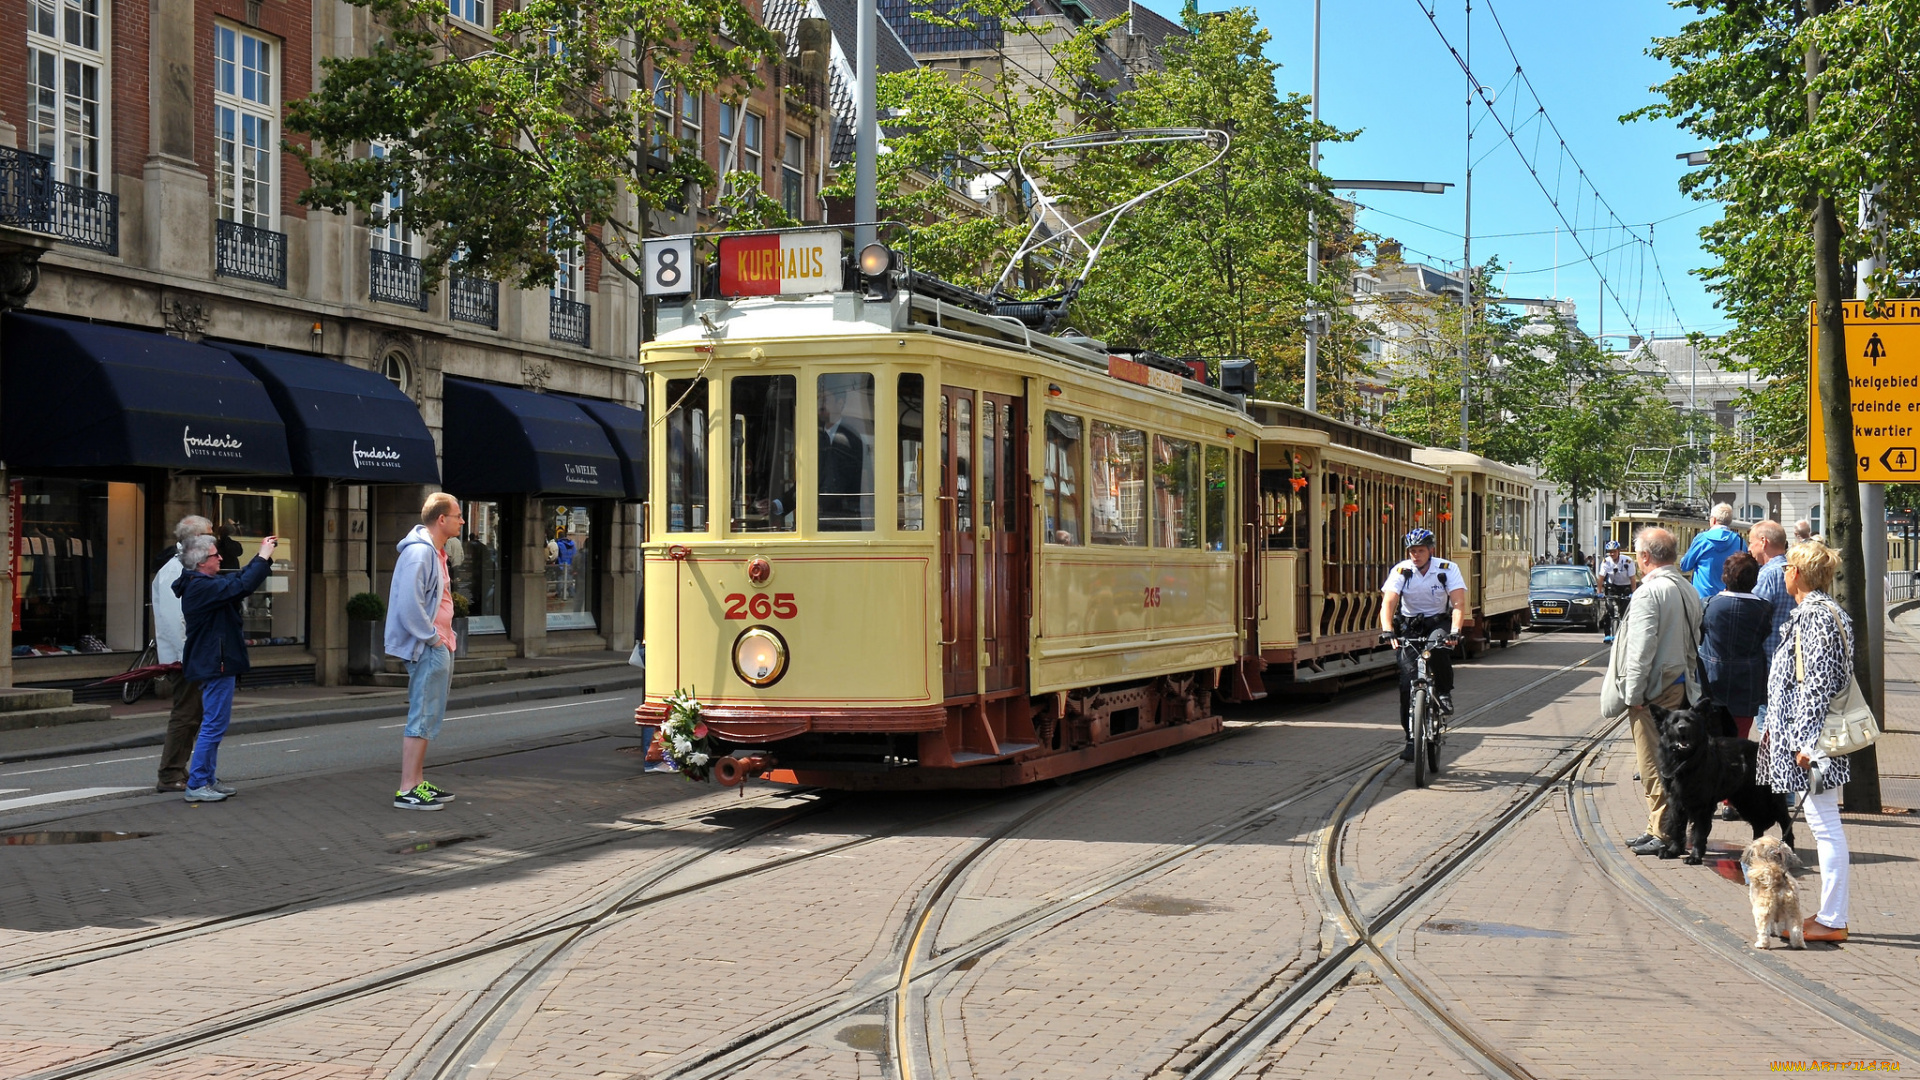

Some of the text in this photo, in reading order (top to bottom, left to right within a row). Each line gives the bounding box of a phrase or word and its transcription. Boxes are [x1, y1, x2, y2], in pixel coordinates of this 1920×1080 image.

[656, 247, 682, 288] 8
[738, 246, 823, 282] KURHAUS
[1851, 400, 1901, 412] rdeinde
[183, 425, 242, 458] fonderie
[1853, 424, 1913, 437] kwartier
[190, 448, 210, 456] SUITS
[218, 450, 243, 458] CASUAL
[352, 440, 401, 469] fonderie
[724, 592, 798, 620] 265
[1143, 586, 1161, 608] 265
